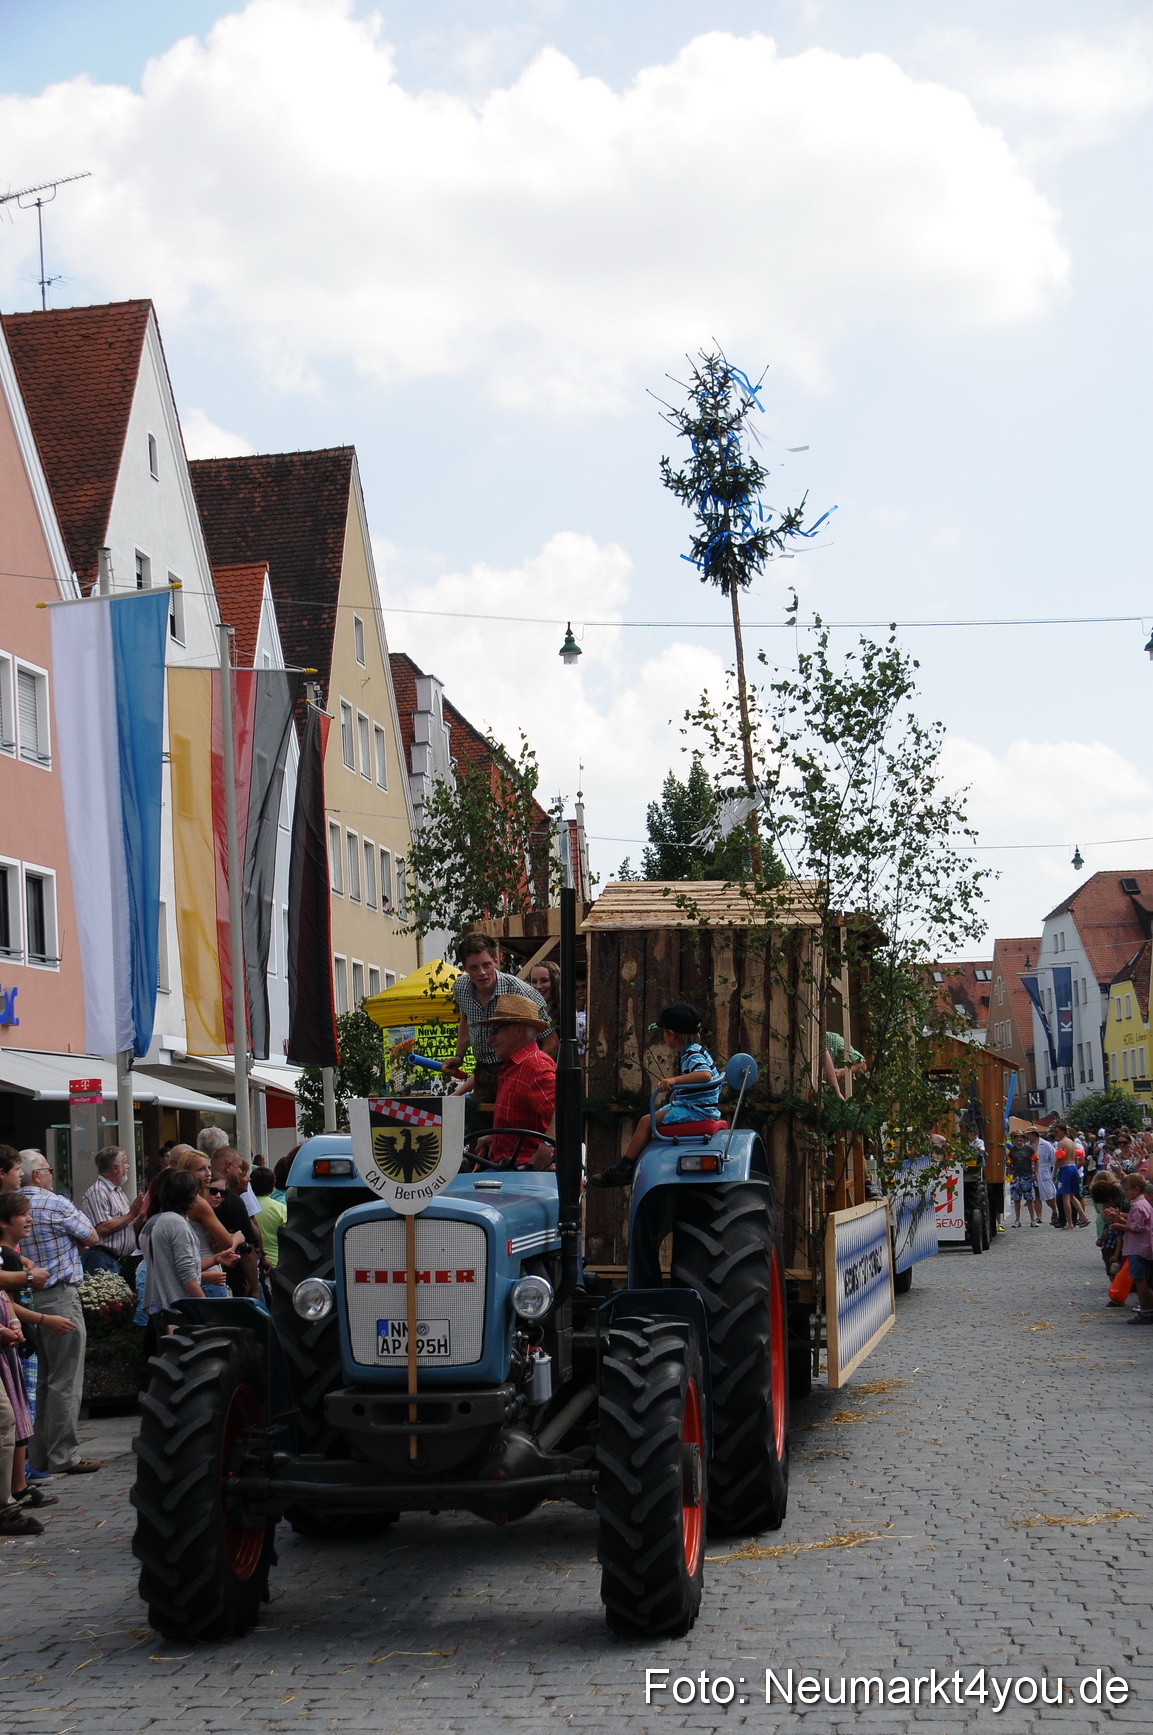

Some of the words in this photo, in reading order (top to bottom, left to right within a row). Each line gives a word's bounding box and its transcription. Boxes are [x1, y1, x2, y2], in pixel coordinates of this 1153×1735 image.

[418, 1028, 438, 1037] New
[365, 1170, 387, 1191] CAJ
[394, 1175, 447, 1200] Berngau
[935, 1218, 964, 1229] GEND
[355, 1269, 475, 1284] EICHER
[381, 1338, 402, 1354] AP
